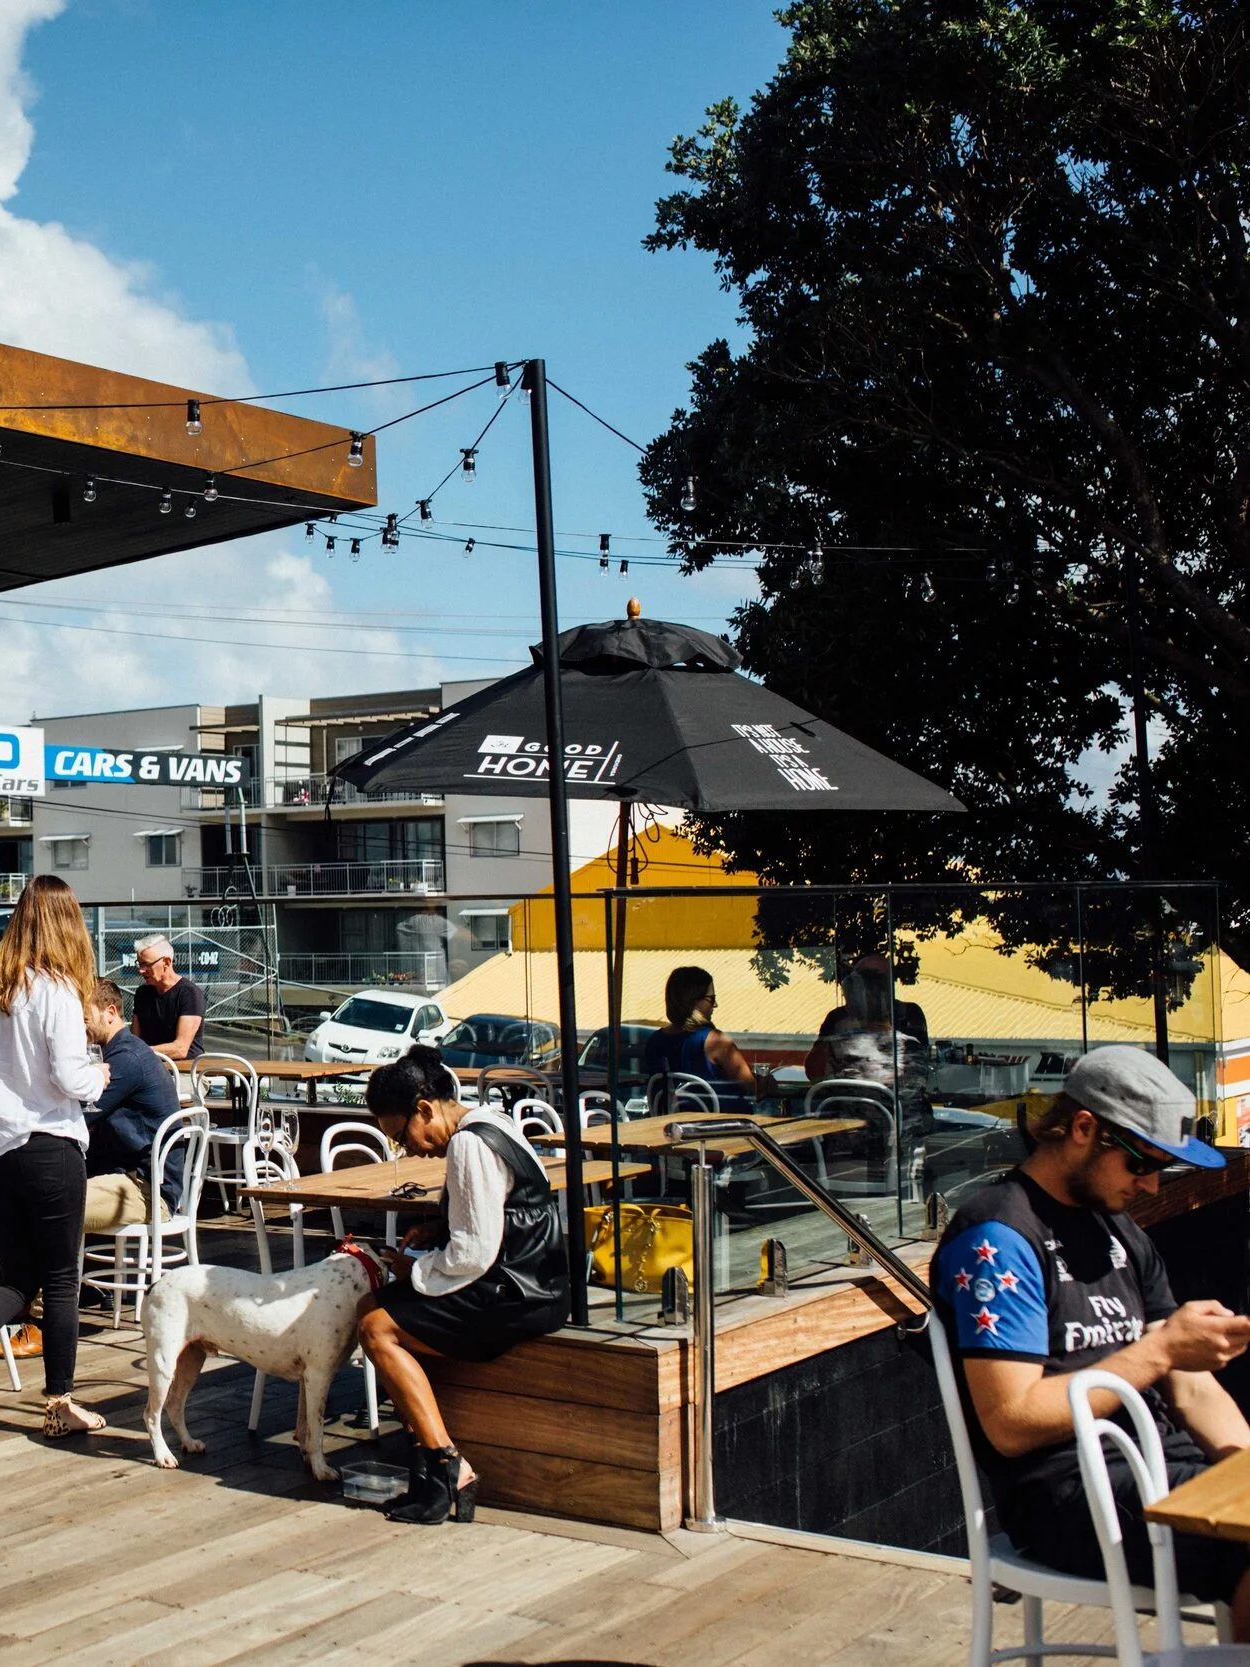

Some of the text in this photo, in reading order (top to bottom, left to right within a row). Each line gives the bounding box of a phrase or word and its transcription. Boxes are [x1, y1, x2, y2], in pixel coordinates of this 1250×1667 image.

[750, 724, 782, 738] NOT
[524, 741, 603, 756] GOD
[748, 738, 811, 754] A HOUSE
[54, 750, 242, 784] CARS & VANS
[791, 754, 809, 768] A
[777, 767, 839, 791] HOME
[1088, 1295, 1127, 1318] Fly
